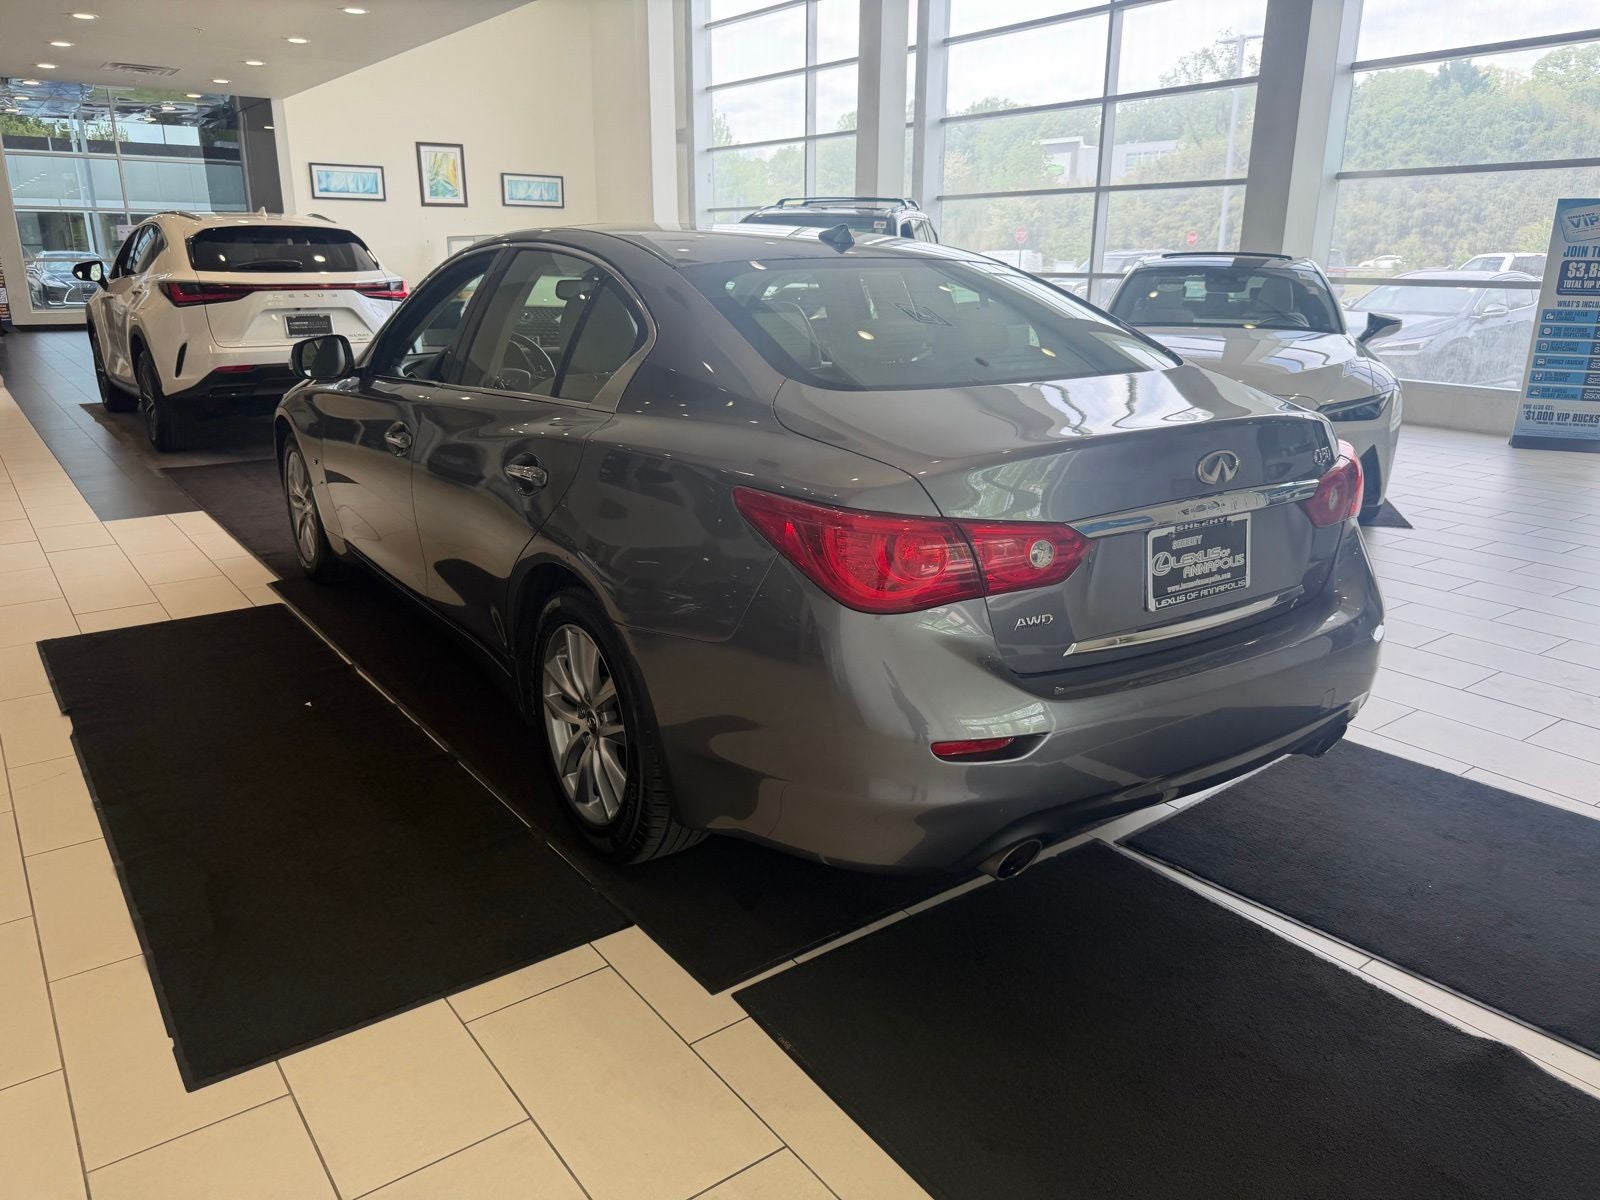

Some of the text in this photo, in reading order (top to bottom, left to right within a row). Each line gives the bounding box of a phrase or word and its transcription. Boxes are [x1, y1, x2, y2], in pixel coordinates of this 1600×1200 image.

[1563, 246, 1589, 258] JOIN
[1563, 280, 1582, 288] TOTAL
[1583, 281, 1594, 289] VIP
[1557, 300, 1600, 309] WHAT'S INCLU
[1525, 411, 1555, 422] $1,000
[1557, 413, 1570, 422] VIP
[1572, 413, 1600, 424] BUCKS
[1177, 516, 1226, 531] SHEEHY
[1172, 546, 1222, 568] LEXUS
[1183, 553, 1245, 579] ANNAPOLIS
[1156, 579, 1246, 608] LEXUS OF ANNAPOLIS
[1014, 613, 1054, 631] AWD
